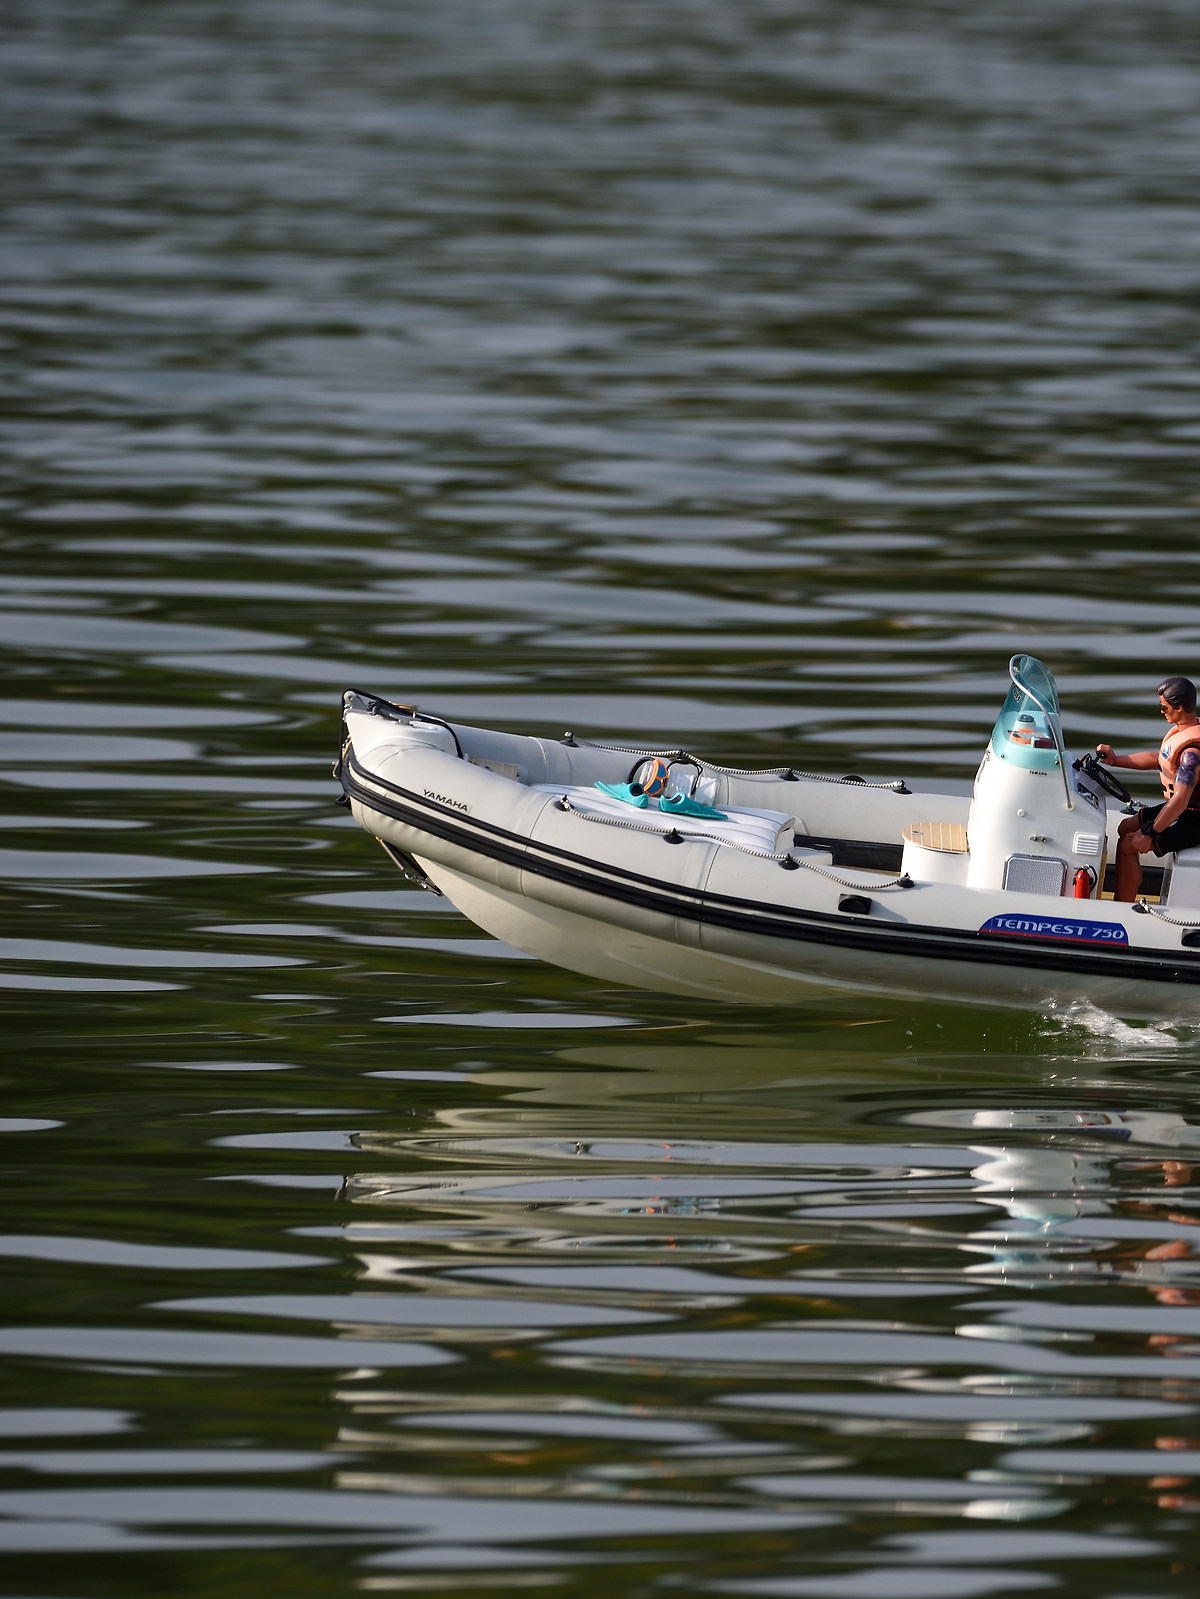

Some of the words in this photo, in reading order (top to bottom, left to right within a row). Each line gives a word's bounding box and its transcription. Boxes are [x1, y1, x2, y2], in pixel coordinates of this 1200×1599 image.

[423, 789, 468, 812] YAMAHA
[994, 917, 1088, 936] TEMPEST
[1091, 927, 1125, 940] 750
